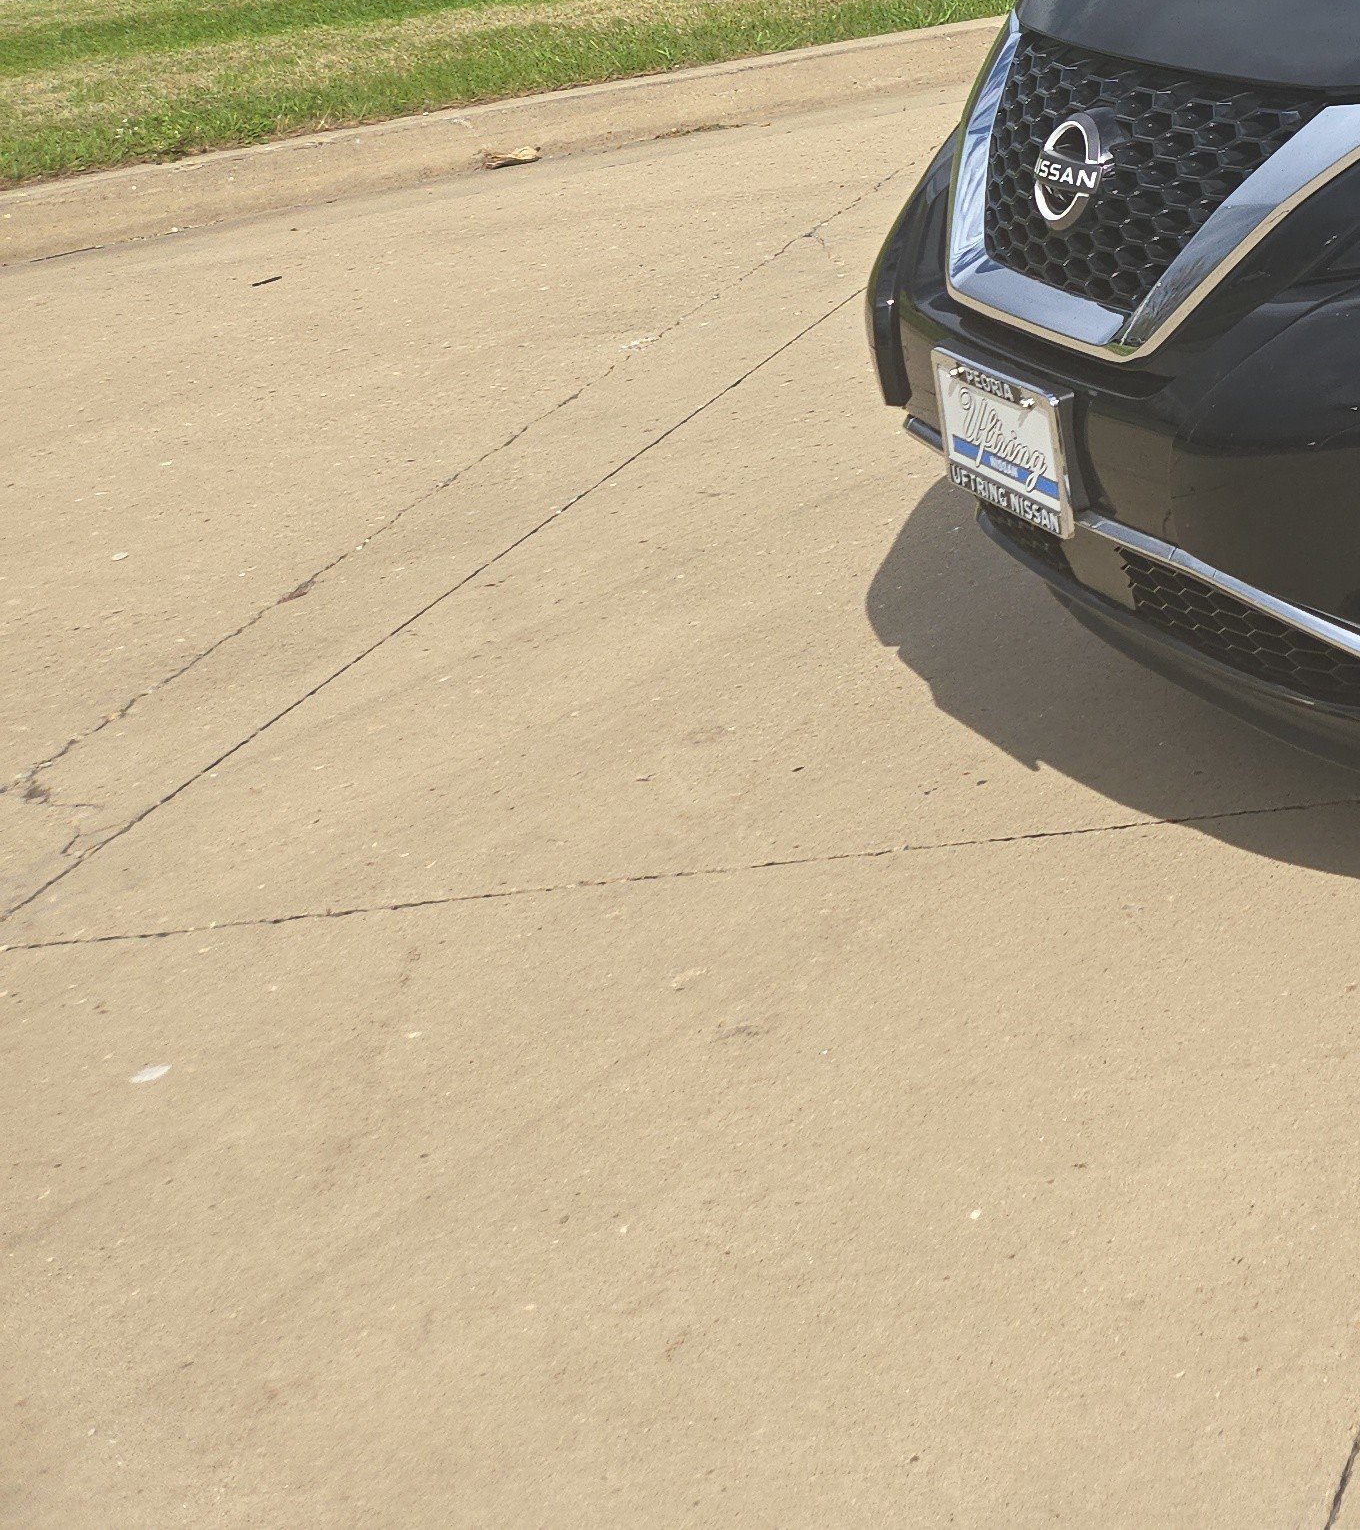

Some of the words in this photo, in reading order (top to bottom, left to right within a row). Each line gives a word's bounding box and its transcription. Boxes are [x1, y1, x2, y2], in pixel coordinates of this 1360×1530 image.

[965, 370, 1014, 402] PEORIA
[960, 387, 1047, 492] Uftring
[951, 466, 1008, 506] UFTRING
[1010, 492, 1061, 533] NISSAN
